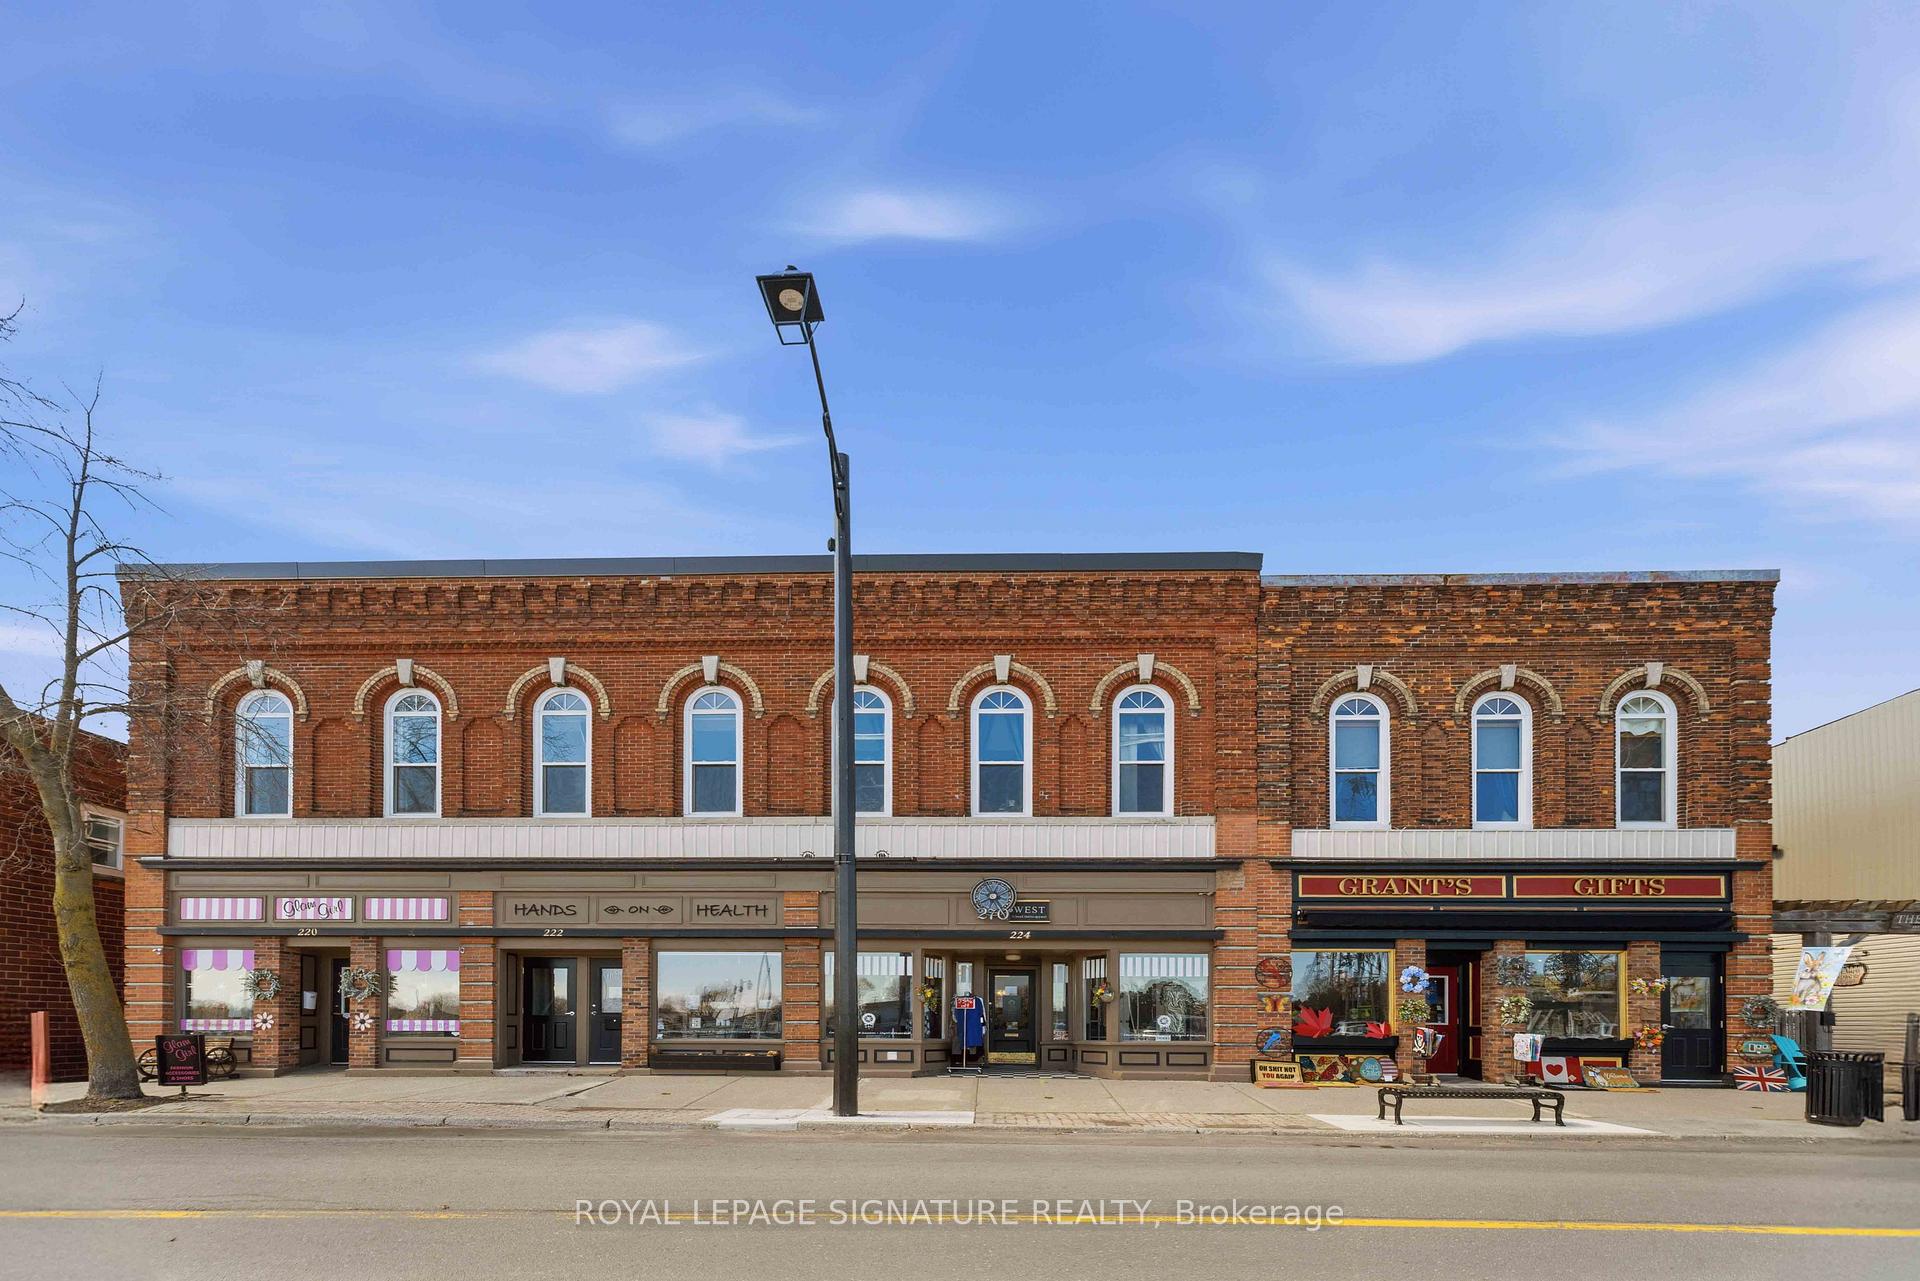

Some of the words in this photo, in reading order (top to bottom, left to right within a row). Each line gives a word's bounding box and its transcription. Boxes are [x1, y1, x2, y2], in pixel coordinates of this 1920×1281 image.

[1338, 877, 1472, 896] GRANT'S
[1574, 877, 1666, 896] GIFTS
[283, 900, 317, 918] Glam
[317, 900, 344, 920] Girl
[514, 904, 577, 917] HANDS
[628, 905, 649, 915] ON
[696, 904, 768, 917] HEALTH
[1014, 906, 1046, 914] WEST
[297, 928, 318, 936] 220
[543, 928, 565, 937] 222
[1009, 931, 1031, 939] 224
[162, 1039, 192, 1054] Glam
[175, 1045, 198, 1062] Girl
[1268, 1065, 1283, 1073] SHIT
